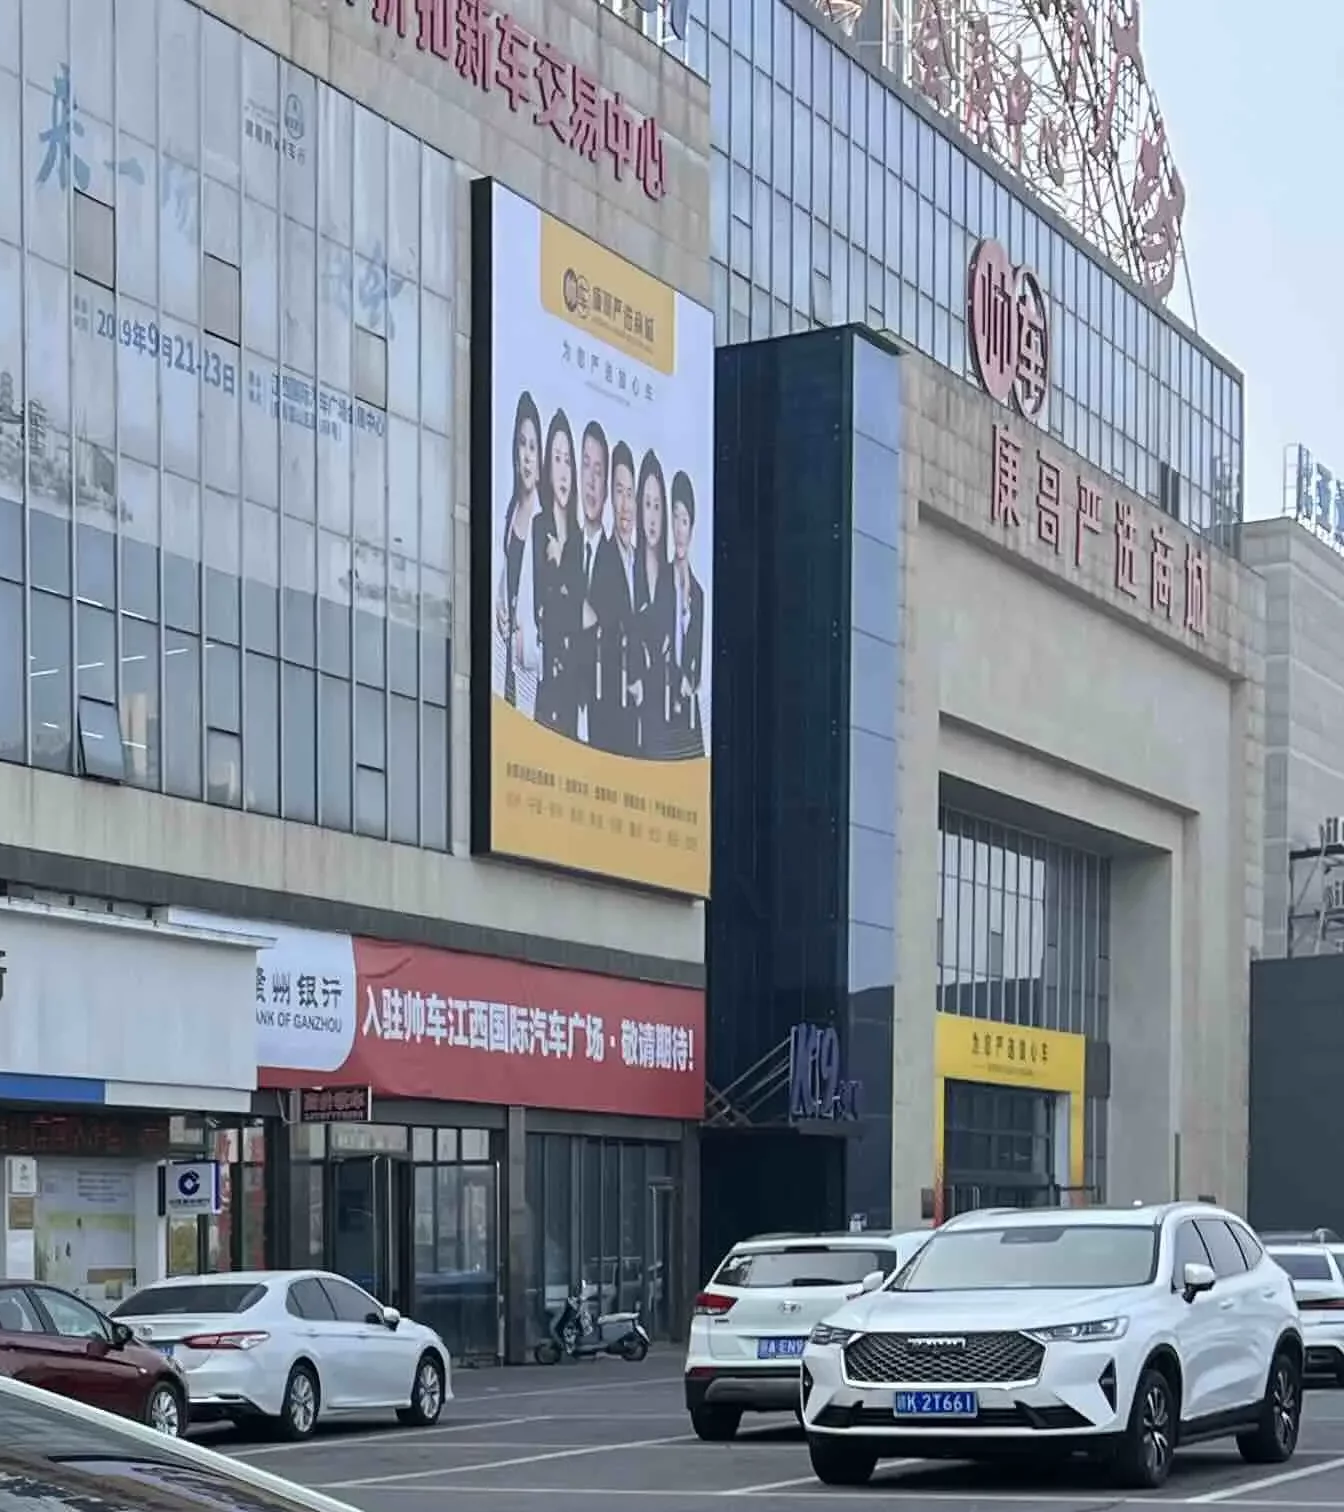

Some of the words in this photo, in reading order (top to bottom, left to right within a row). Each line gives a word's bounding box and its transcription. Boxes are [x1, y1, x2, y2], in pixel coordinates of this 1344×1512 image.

[991, 423, 1211, 638] 康哥严选商城
[293, 1013, 342, 1034] GANZHOU
